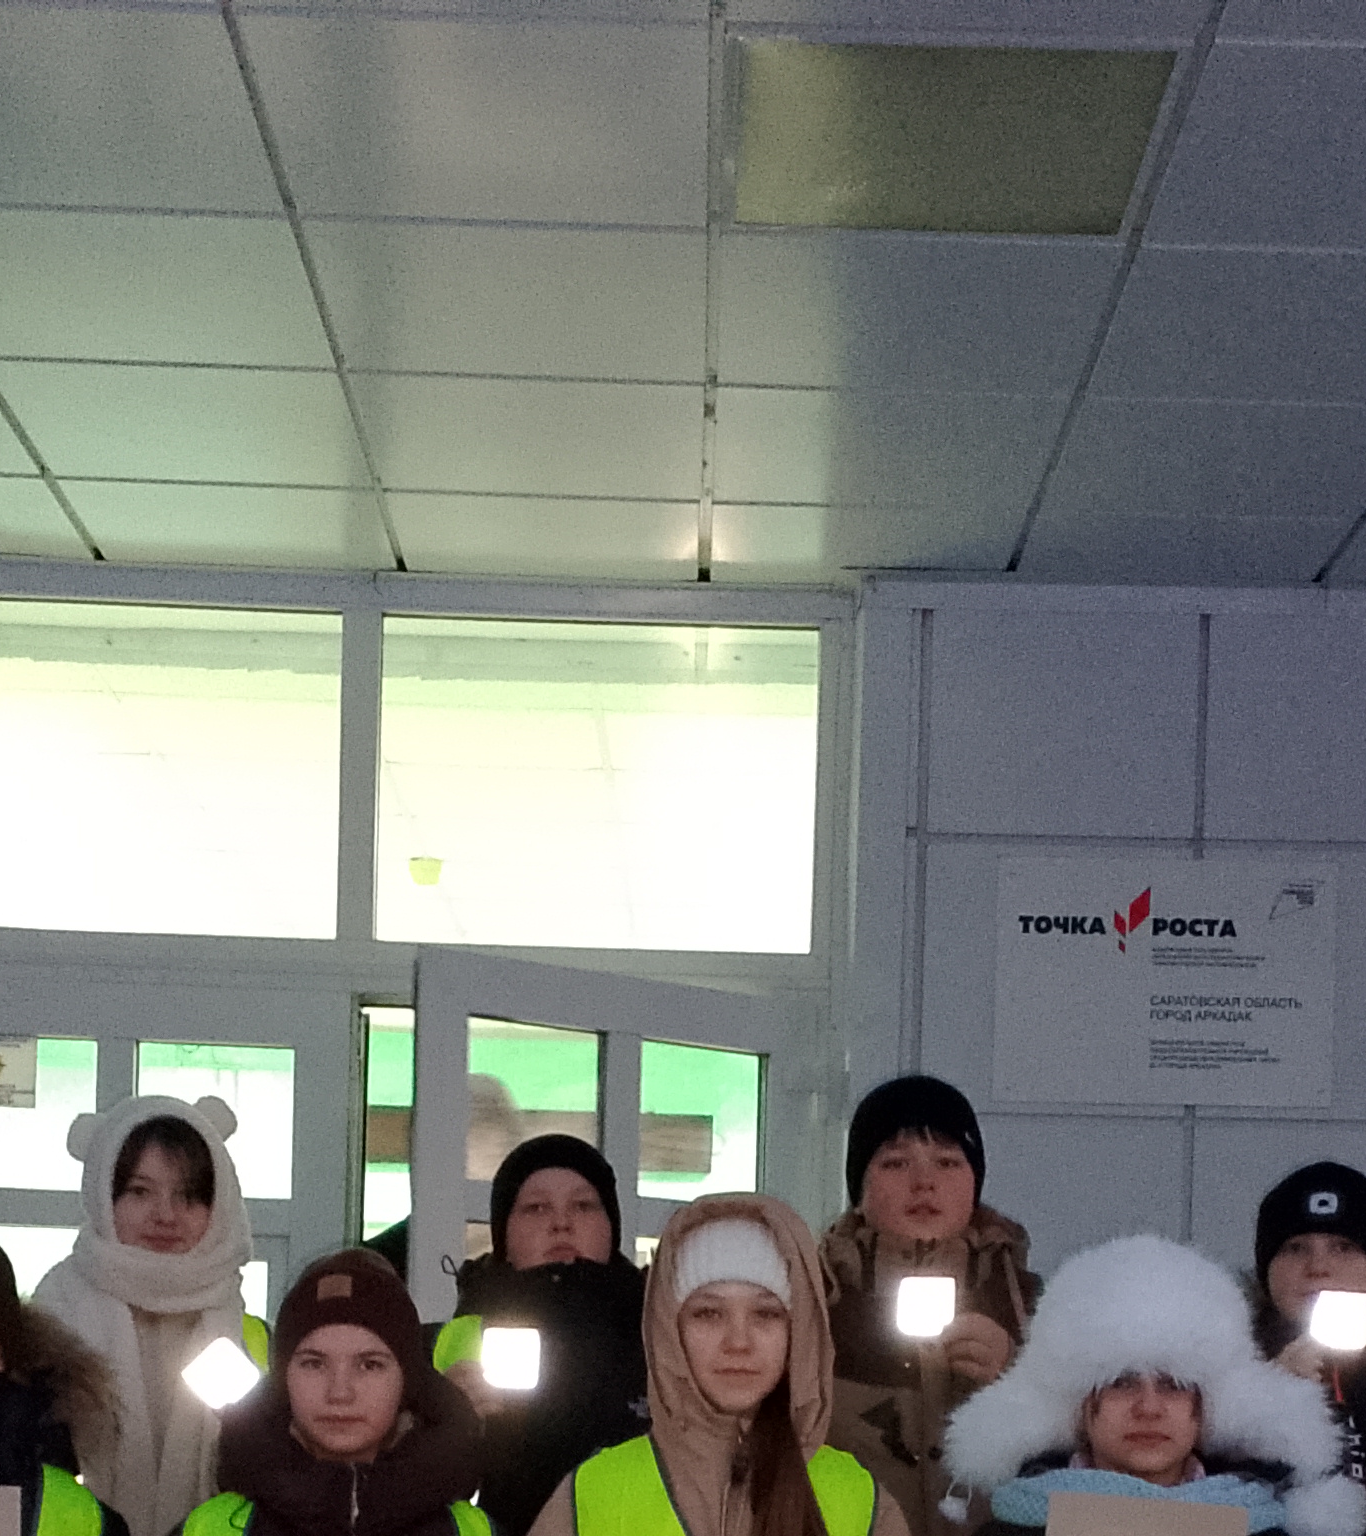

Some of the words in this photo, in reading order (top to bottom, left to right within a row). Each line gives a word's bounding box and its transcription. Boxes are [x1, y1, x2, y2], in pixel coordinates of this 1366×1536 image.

[1018, 914, 1107, 936] ТОЧКА
[1151, 917, 1238, 938] РОСТА
[1149, 995, 1241, 1010] САРАТОВСКАЯ
[1243, 996, 1304, 1010] ОБЛАСТЬ
[1149, 1009, 1193, 1023] ГОРОД
[1194, 1010, 1254, 1024] АРКАДАК
